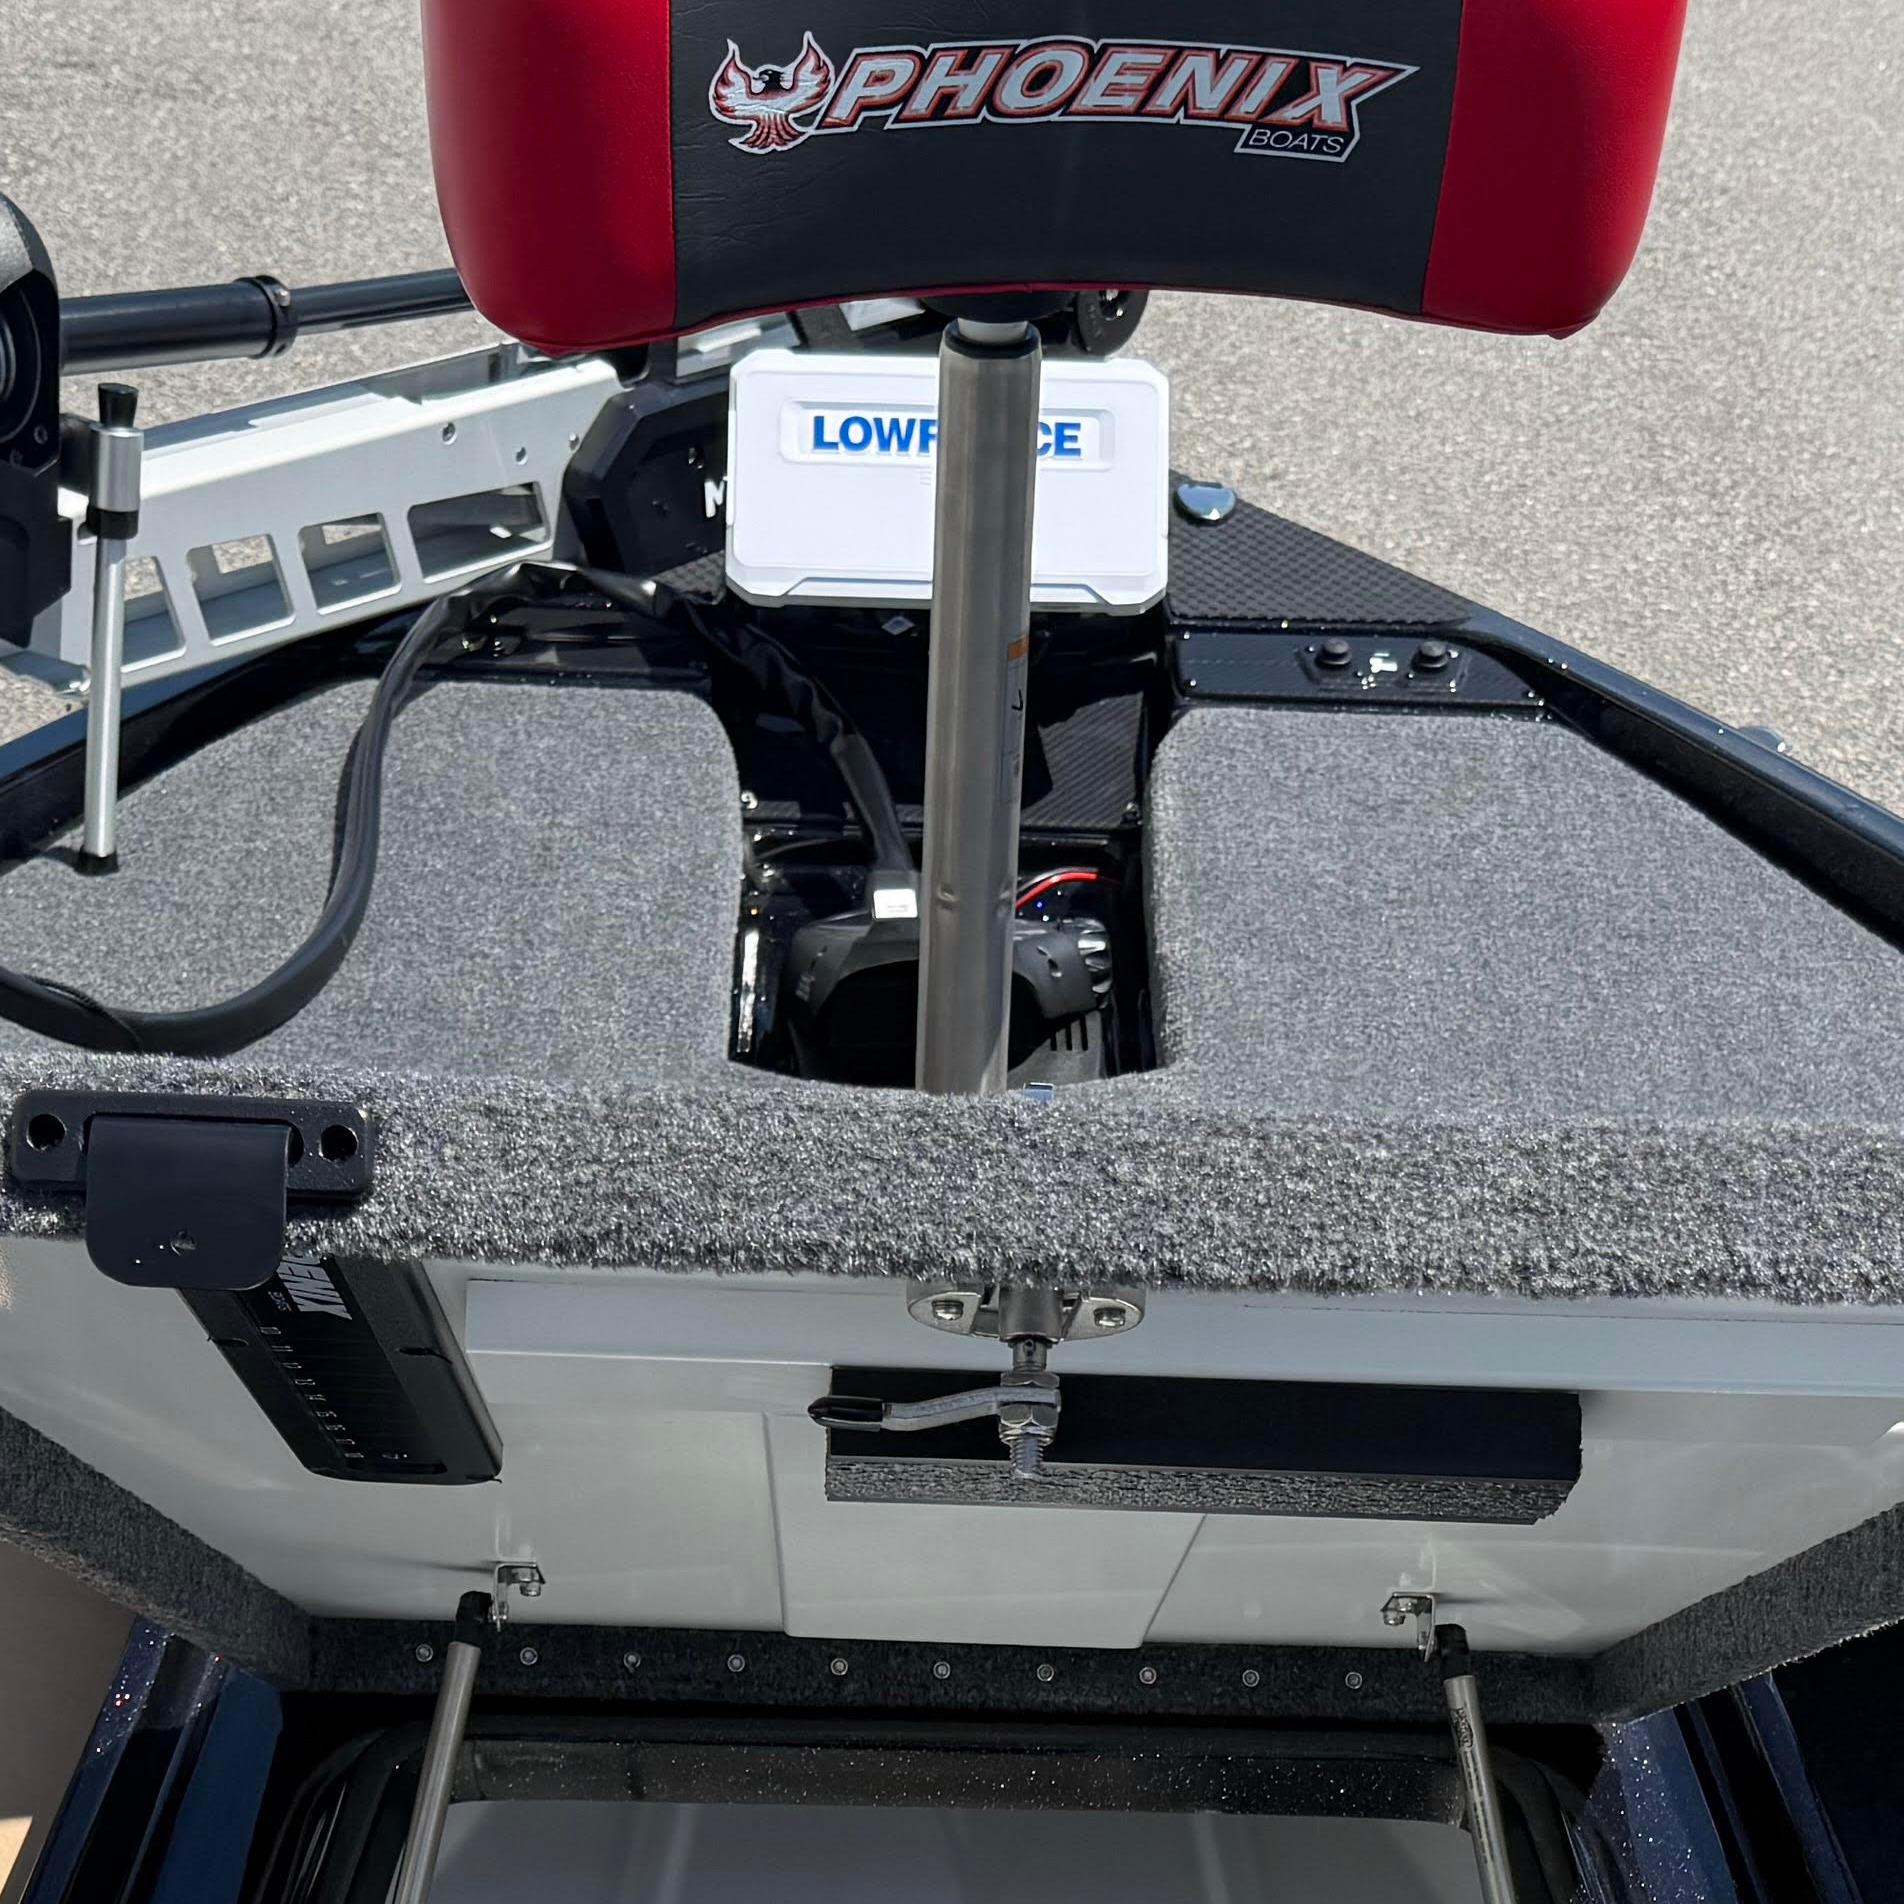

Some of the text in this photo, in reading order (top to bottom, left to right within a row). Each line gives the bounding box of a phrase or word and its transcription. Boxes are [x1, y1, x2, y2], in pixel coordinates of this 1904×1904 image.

[821, 46, 1382, 131] PHOENIX
[1249, 128, 1345, 154] BOATS
[813, 415, 1082, 457] LOWRE
